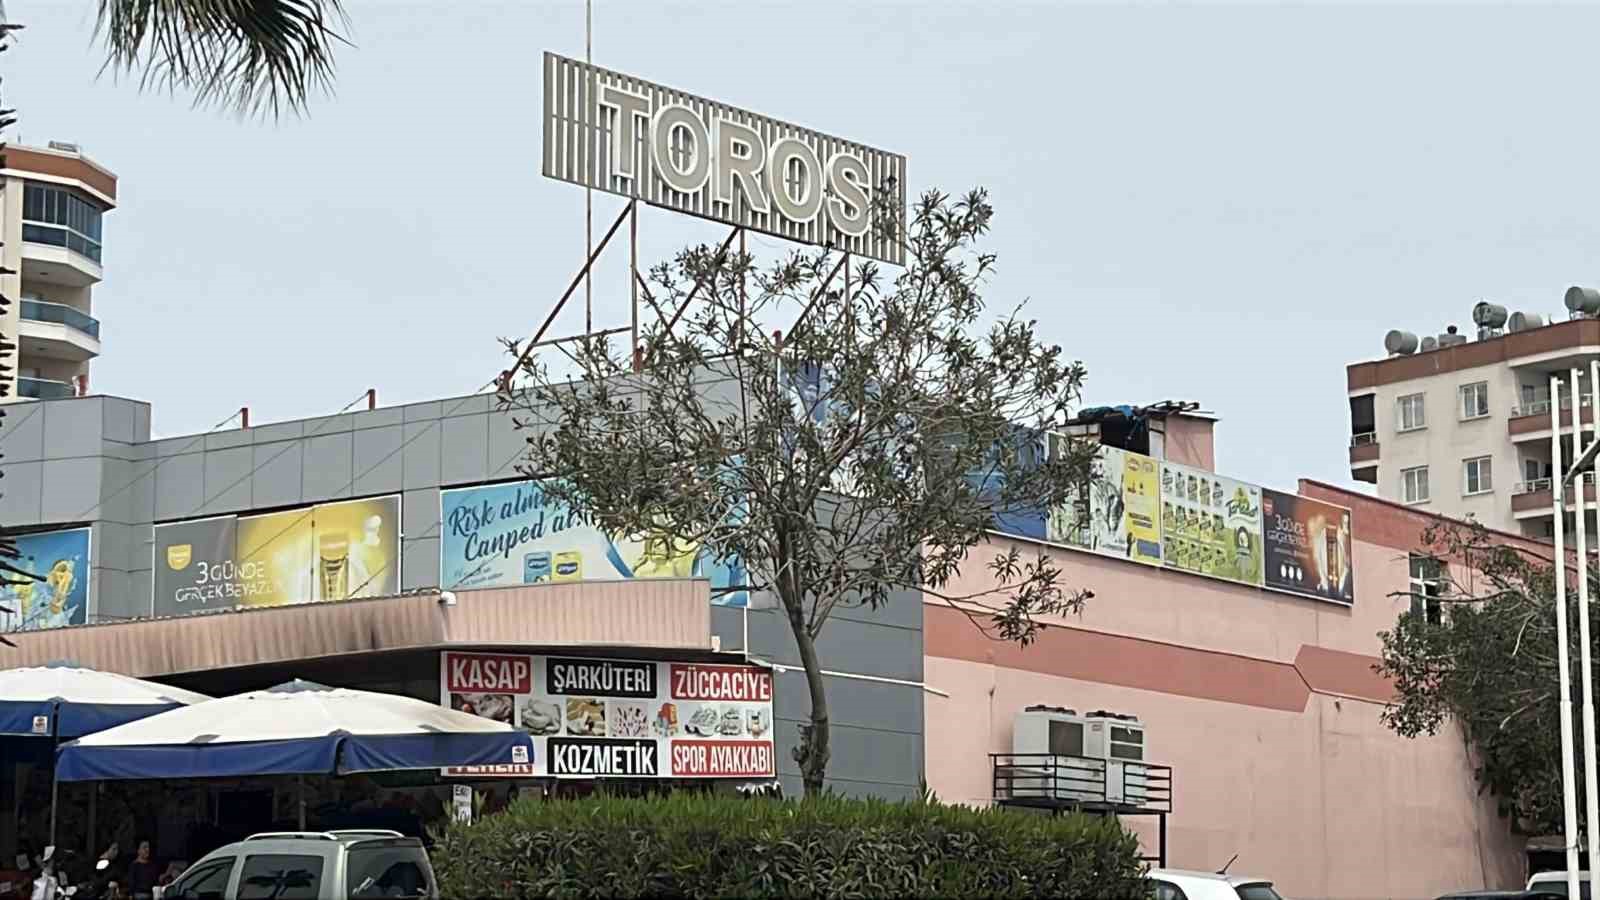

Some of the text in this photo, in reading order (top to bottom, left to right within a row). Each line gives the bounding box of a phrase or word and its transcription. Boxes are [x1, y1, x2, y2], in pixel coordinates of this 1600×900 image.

[597, 83, 872, 237] TOROS
[448, 500, 495, 537] Risk
[464, 511, 546, 561] Canped
[452, 659, 528, 690] KASAP
[553, 662, 651, 693] ŞARKÜTERİ
[675, 667, 770, 700] ZÜCCACİYE
[553, 741, 655, 775] KOZMETİK
[673, 746, 770, 773] SPOR AYAKKABI
